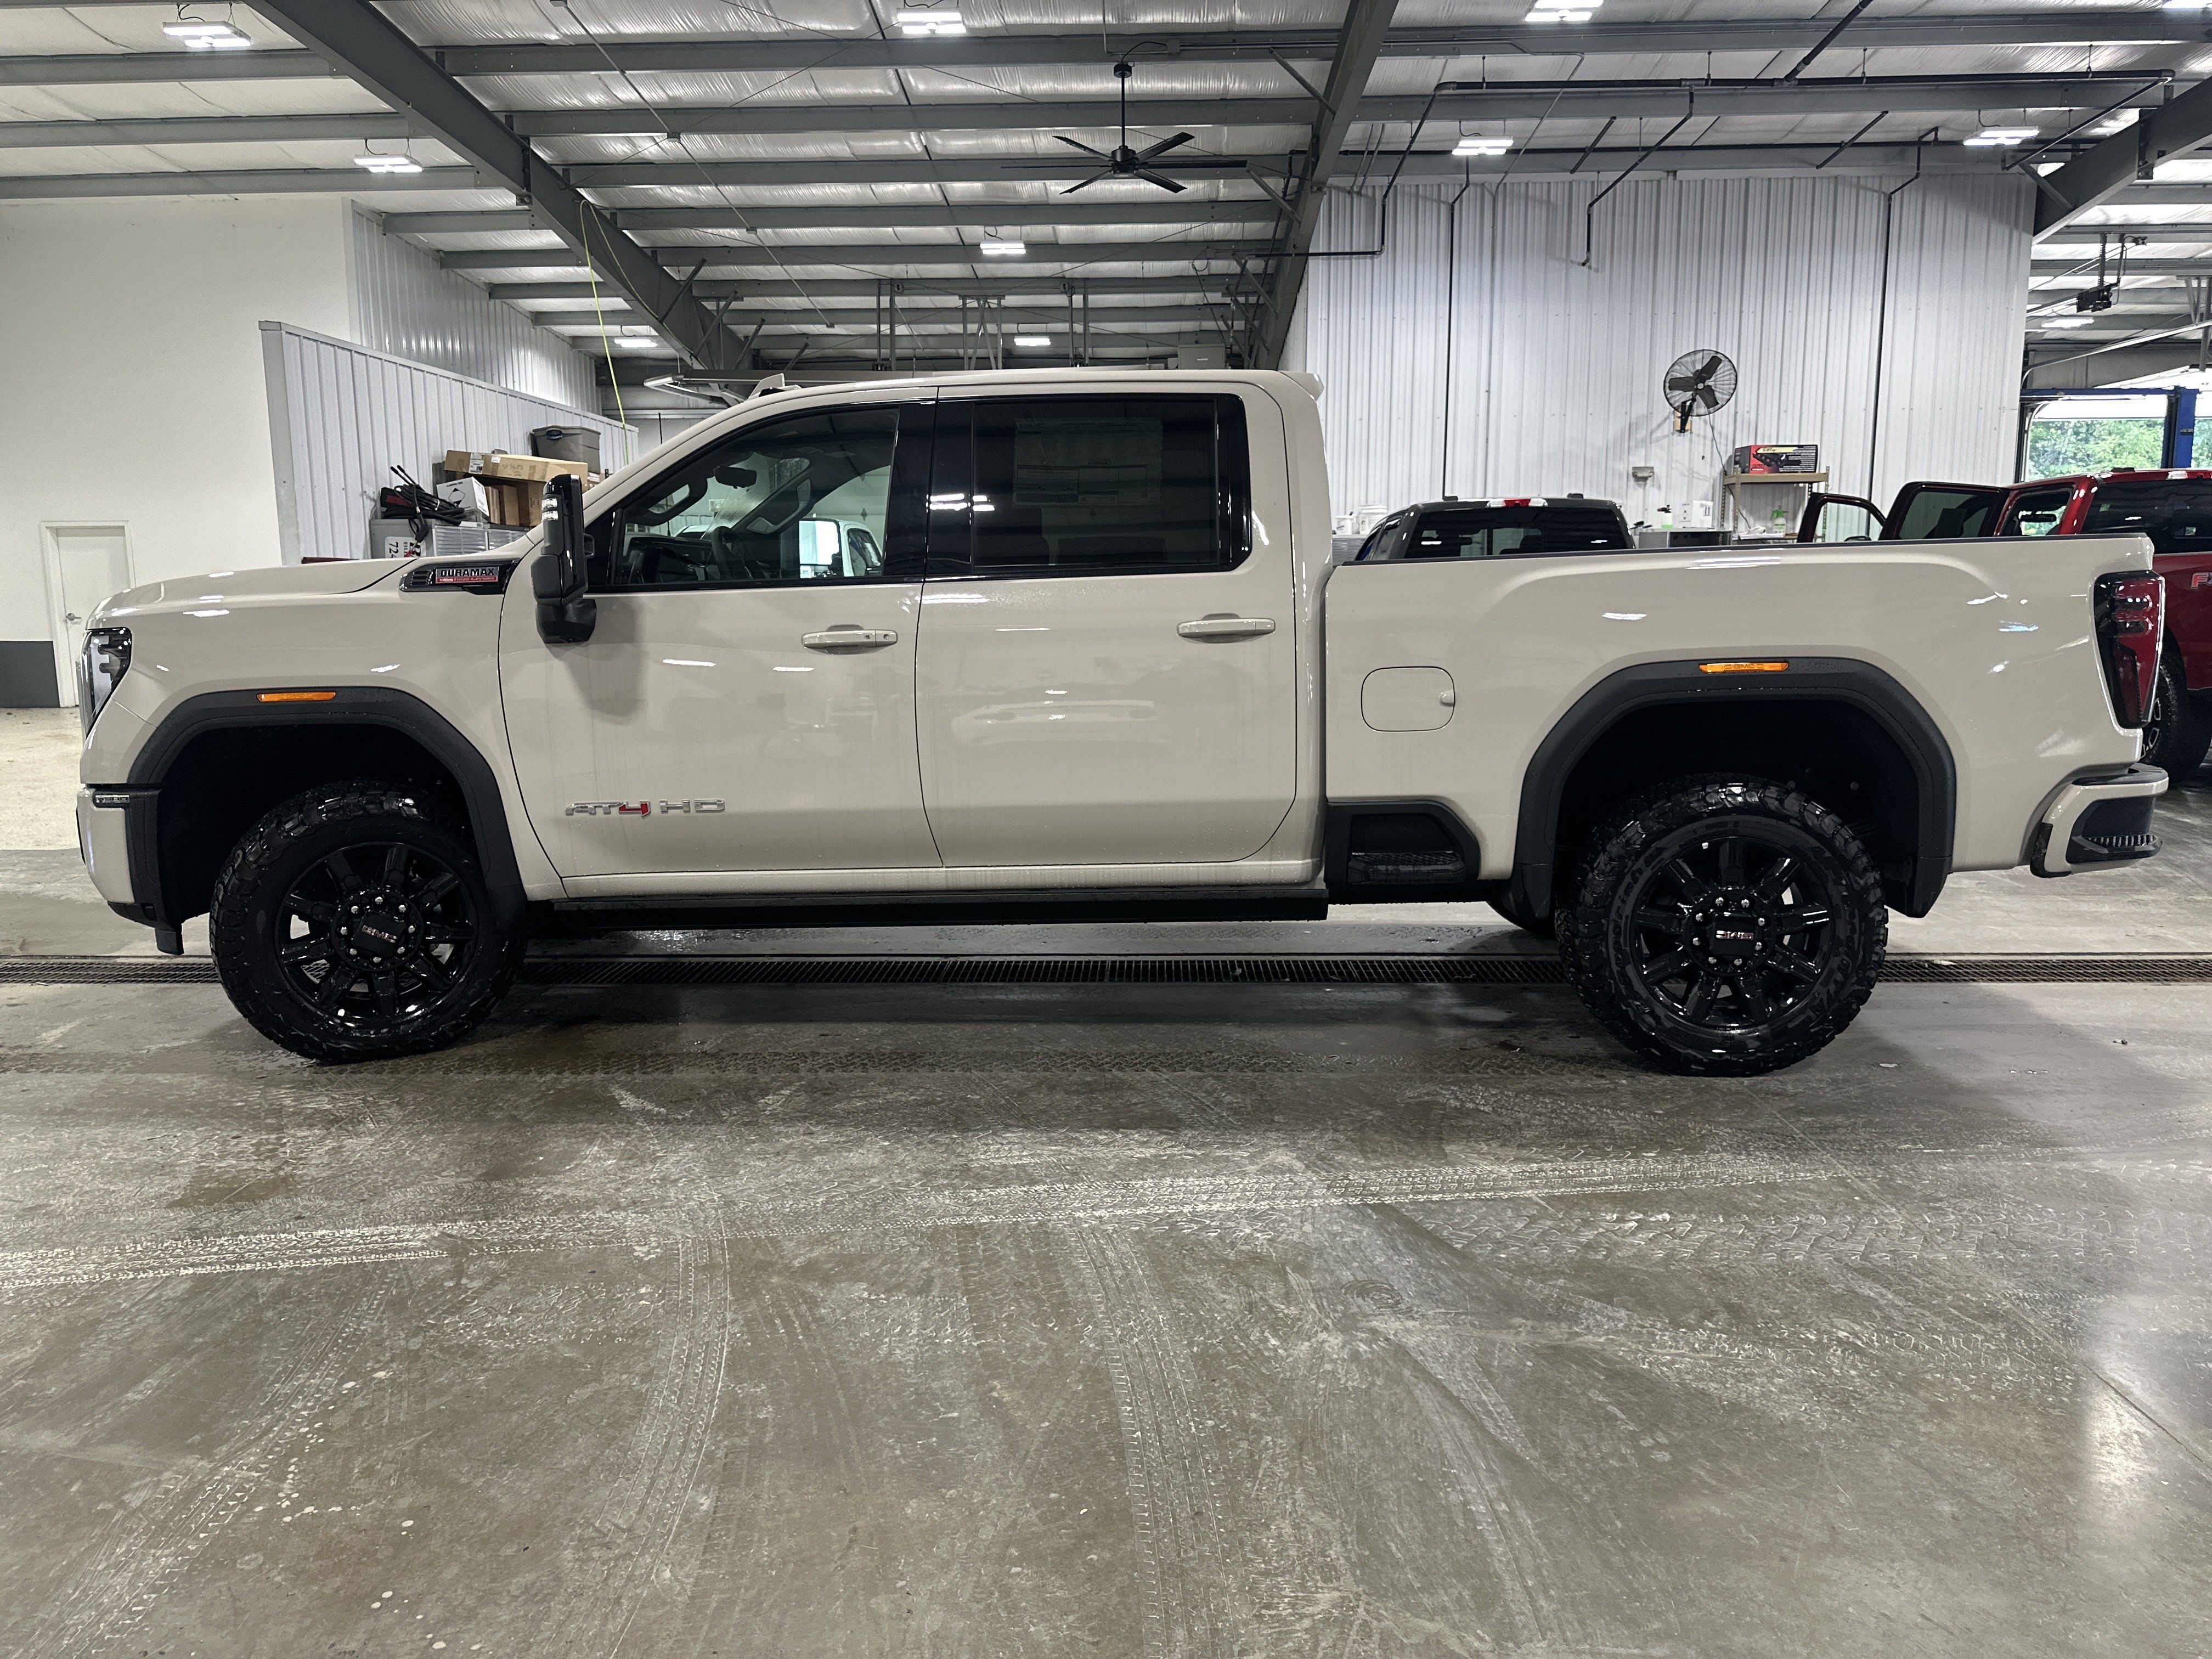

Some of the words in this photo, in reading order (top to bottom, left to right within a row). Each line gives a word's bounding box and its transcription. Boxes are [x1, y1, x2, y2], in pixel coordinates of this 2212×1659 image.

[441, 568, 495, 577] DURAMAX
[566, 799, 651, 817] AT4
[659, 799, 725, 812] HD
[362, 925, 397, 943] GMC
[1716, 930, 1754, 940] GMC
